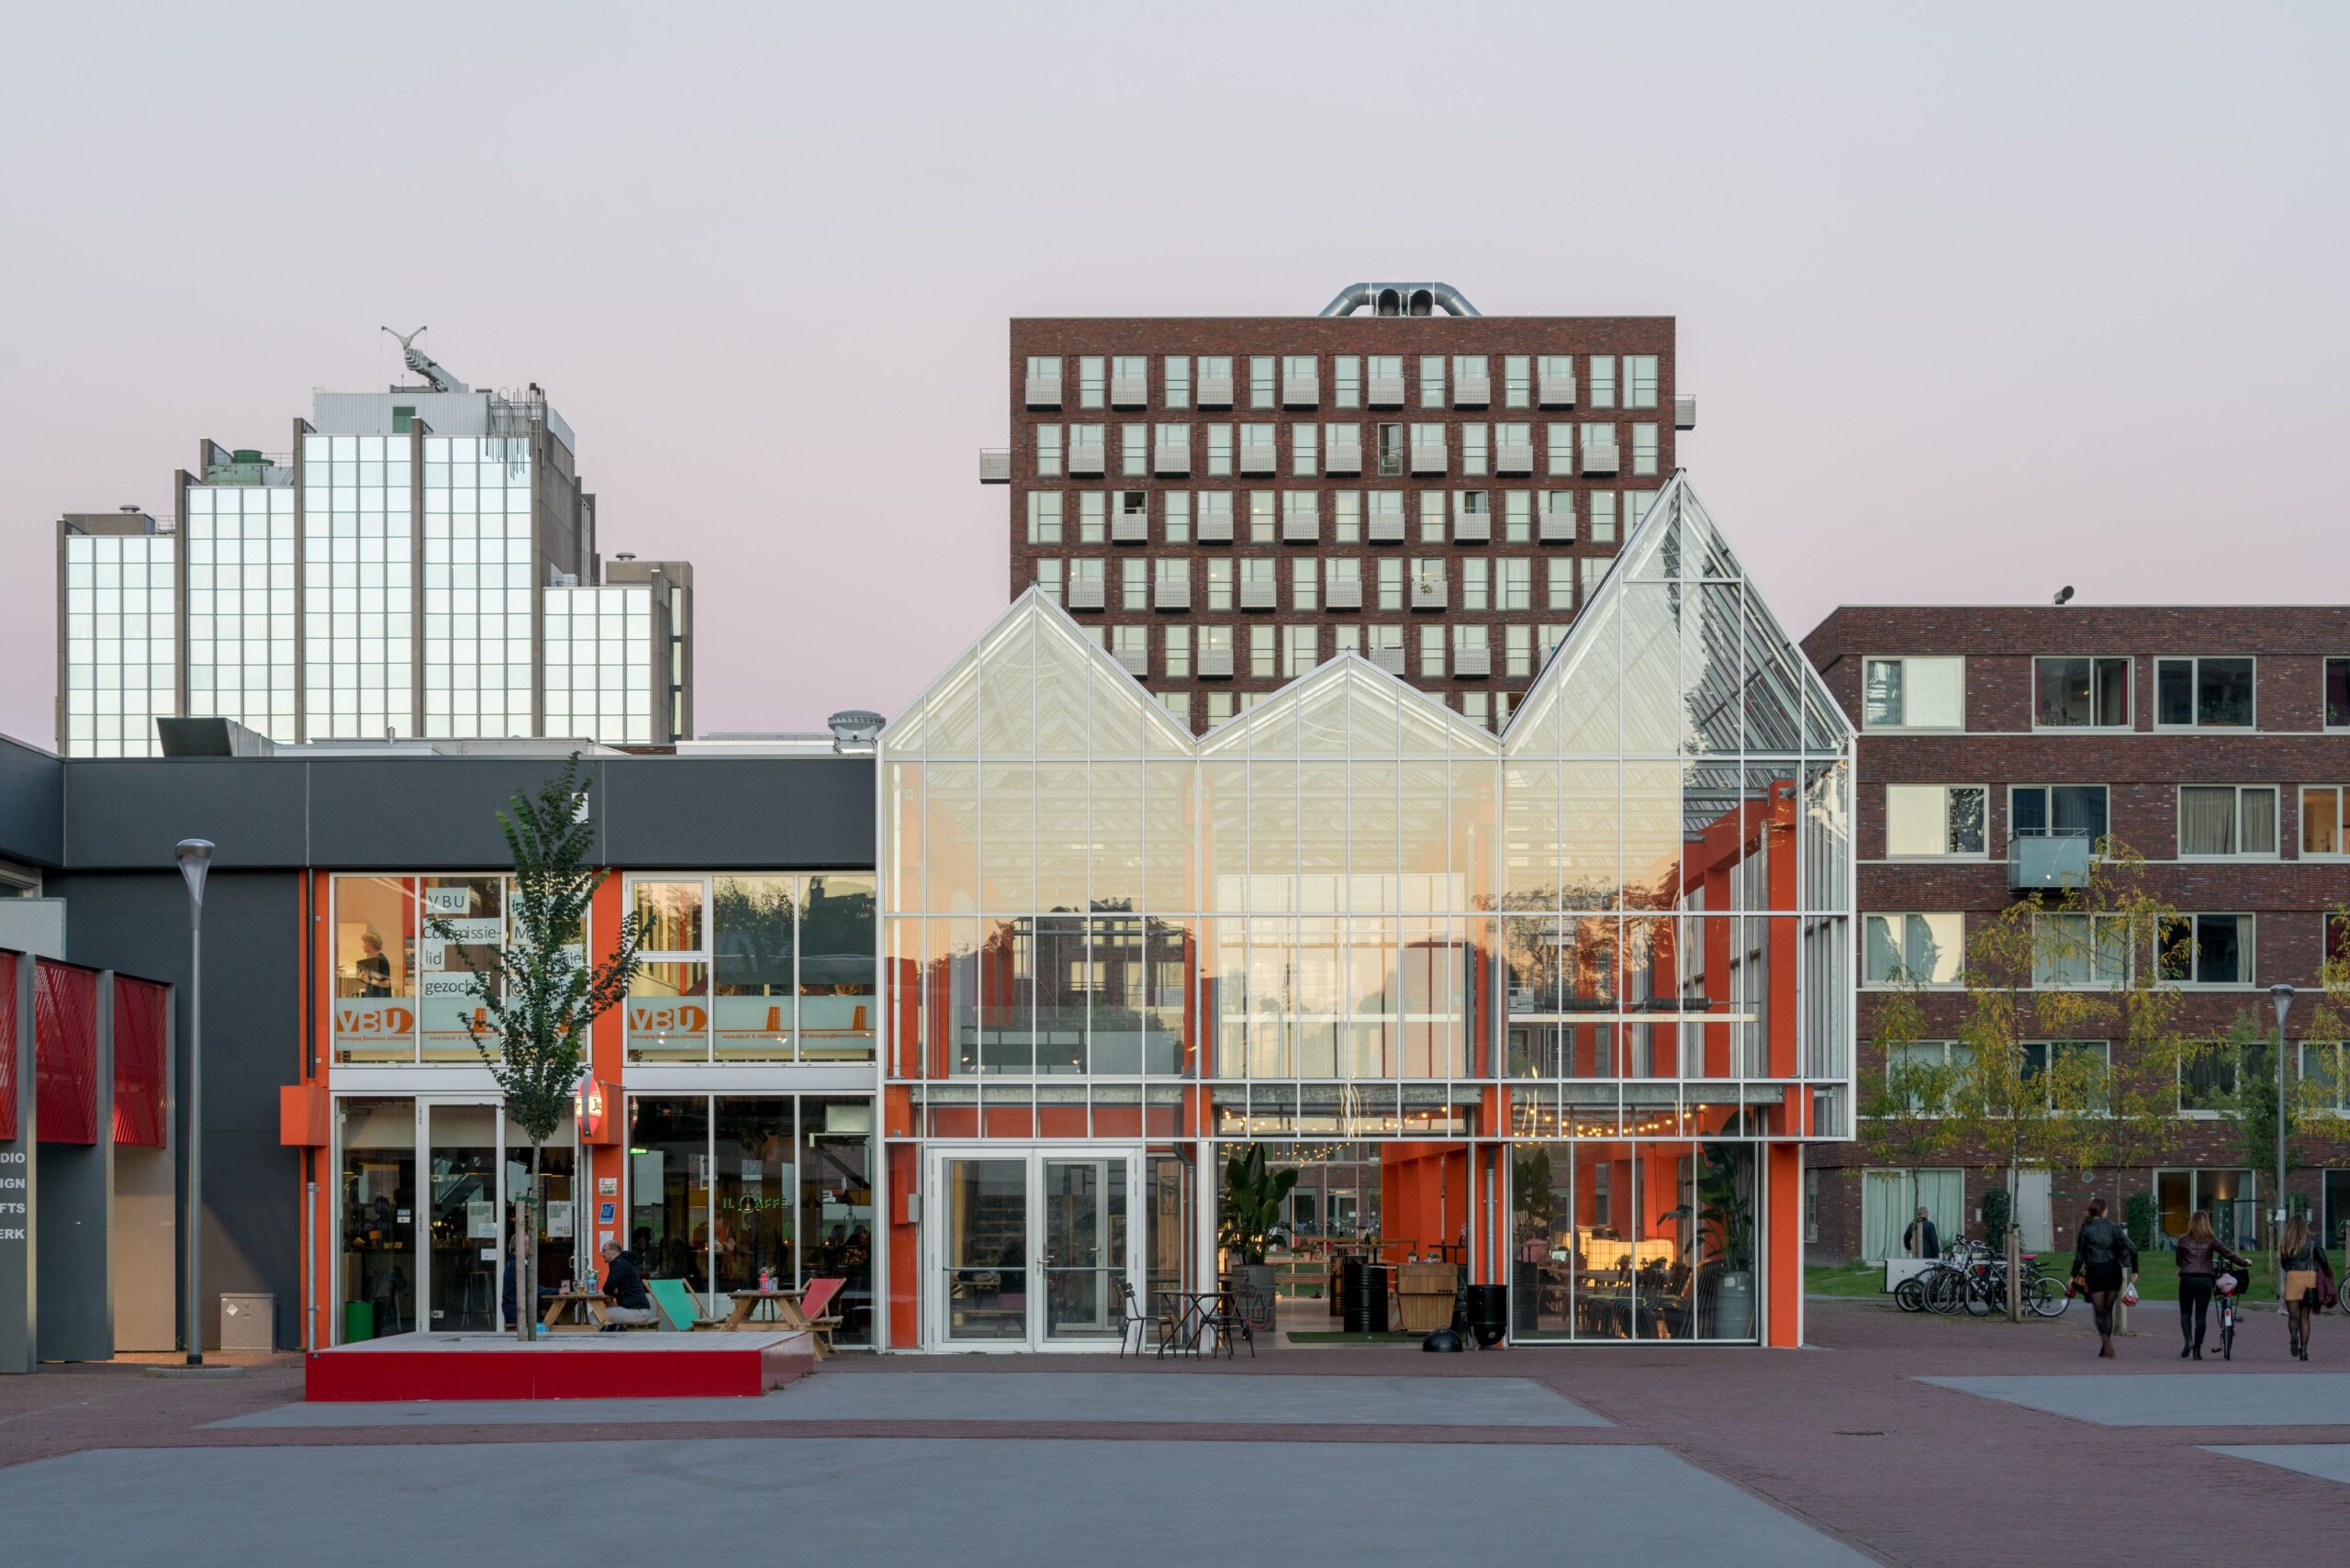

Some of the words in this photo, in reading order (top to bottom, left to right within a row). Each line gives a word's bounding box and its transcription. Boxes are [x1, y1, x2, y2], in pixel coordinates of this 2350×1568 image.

[428, 895, 464, 909] VBU
[425, 950, 442, 966] lid
[337, 1008, 402, 1035] VBU
[630, 1006, 695, 1032] VBU
[0, 1153, 26, 1163] DIO
